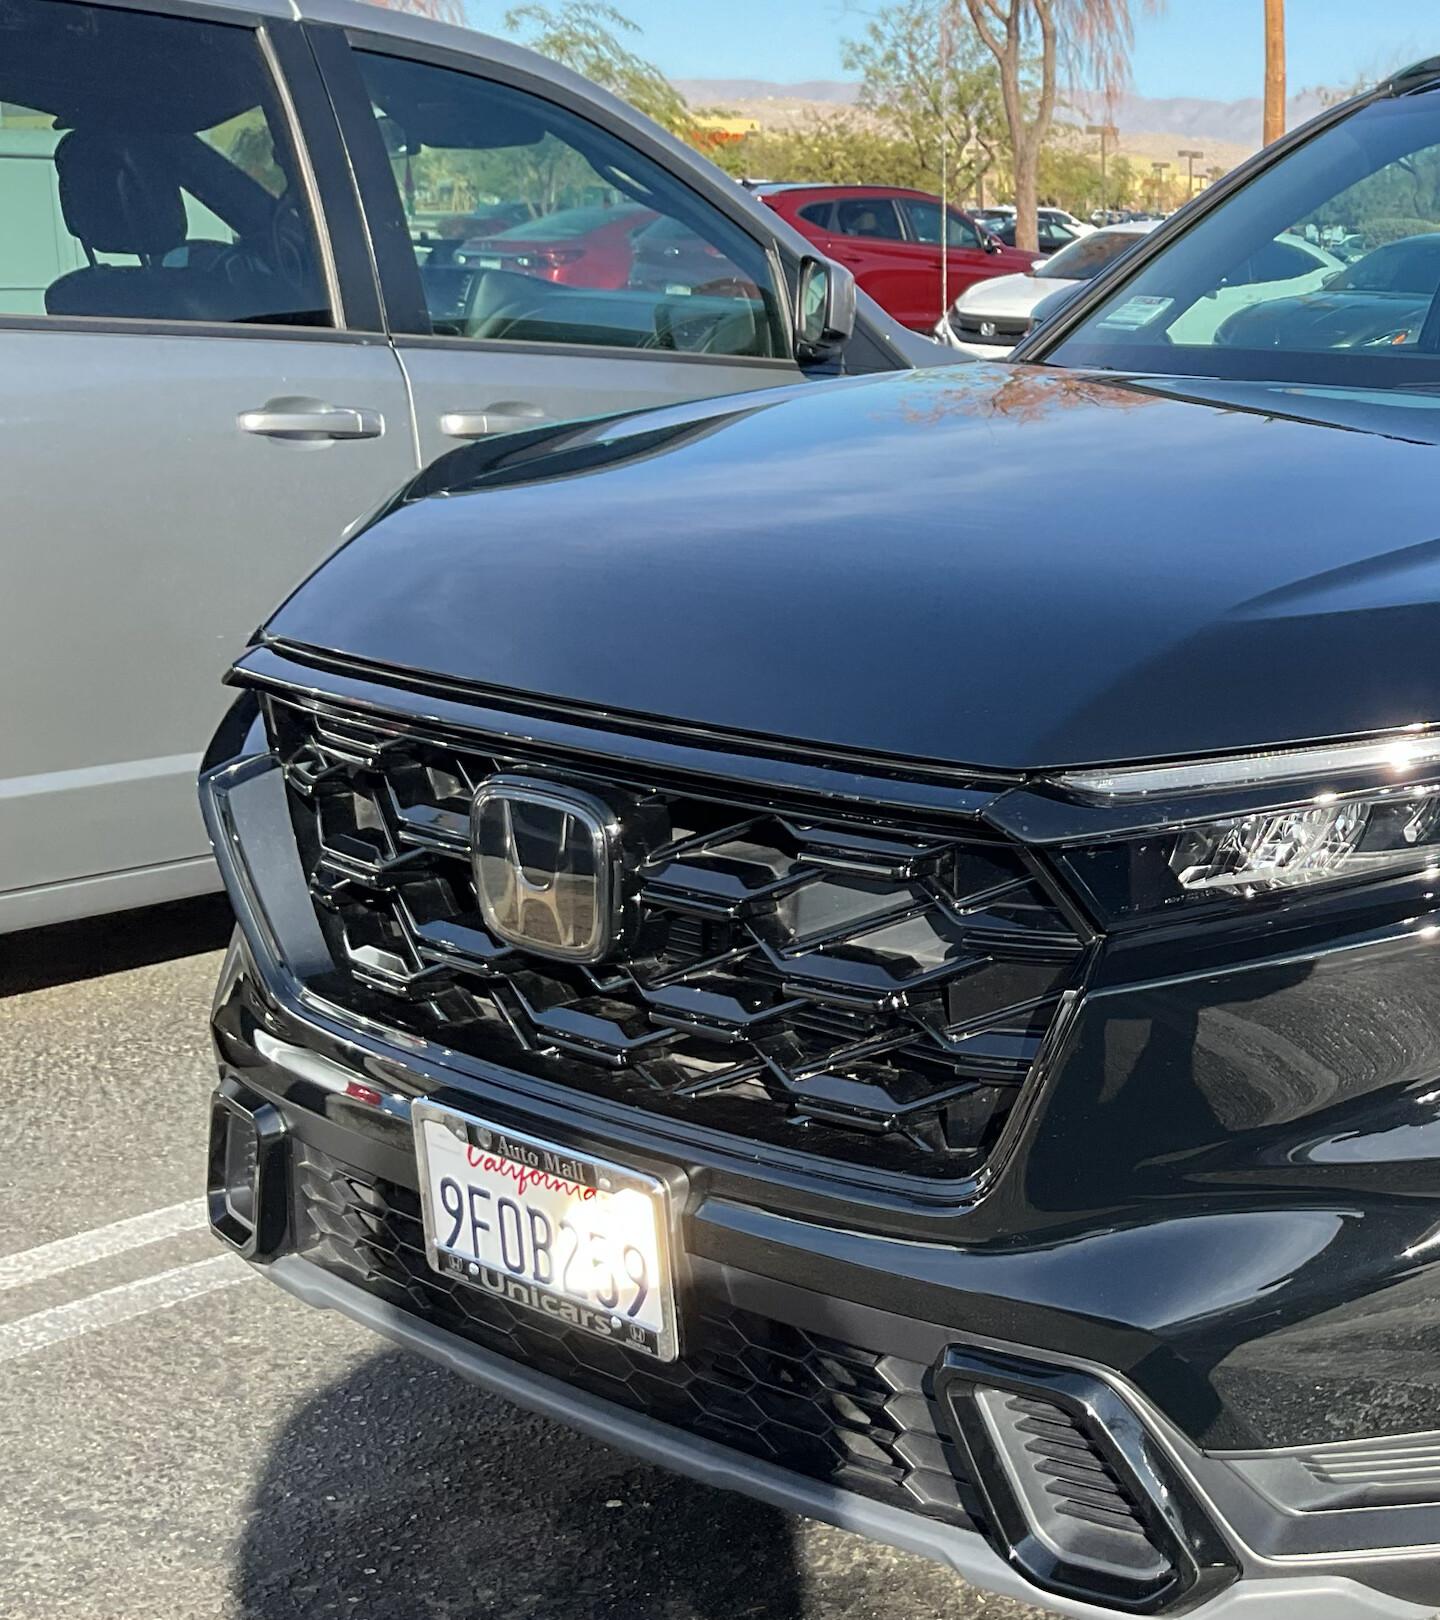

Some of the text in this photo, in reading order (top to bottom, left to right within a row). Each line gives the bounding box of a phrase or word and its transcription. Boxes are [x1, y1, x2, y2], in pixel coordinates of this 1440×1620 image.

[467, 1144, 598, 1201] California
[497, 1136, 586, 1183] Auto Mall
[481, 1266, 612, 1336] Unicars
